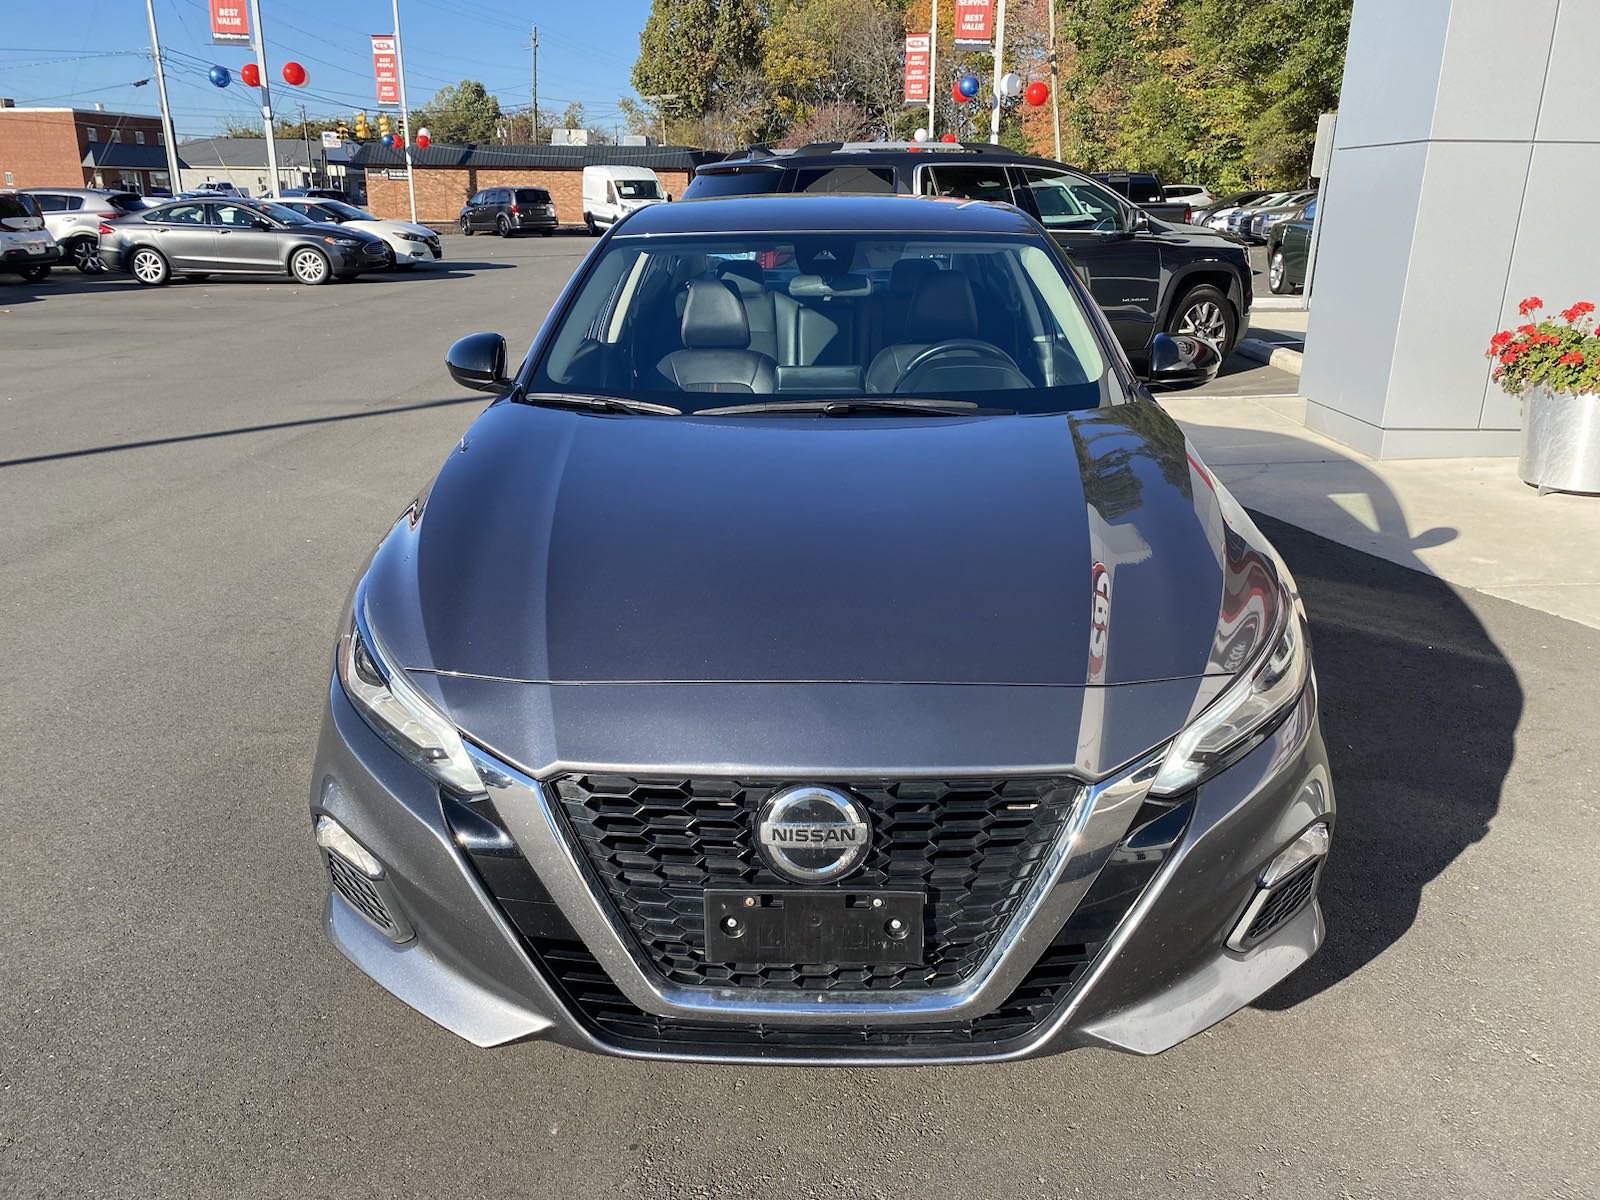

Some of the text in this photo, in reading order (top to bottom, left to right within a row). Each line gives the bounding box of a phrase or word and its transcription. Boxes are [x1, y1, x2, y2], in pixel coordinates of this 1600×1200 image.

[218, 8, 239, 16] BEST
[217, 17, 241, 25] VALUE
[964, 14, 984, 22] BEST
[962, 22, 985, 31] VALUE
[771, 828, 856, 843] NISSAN
